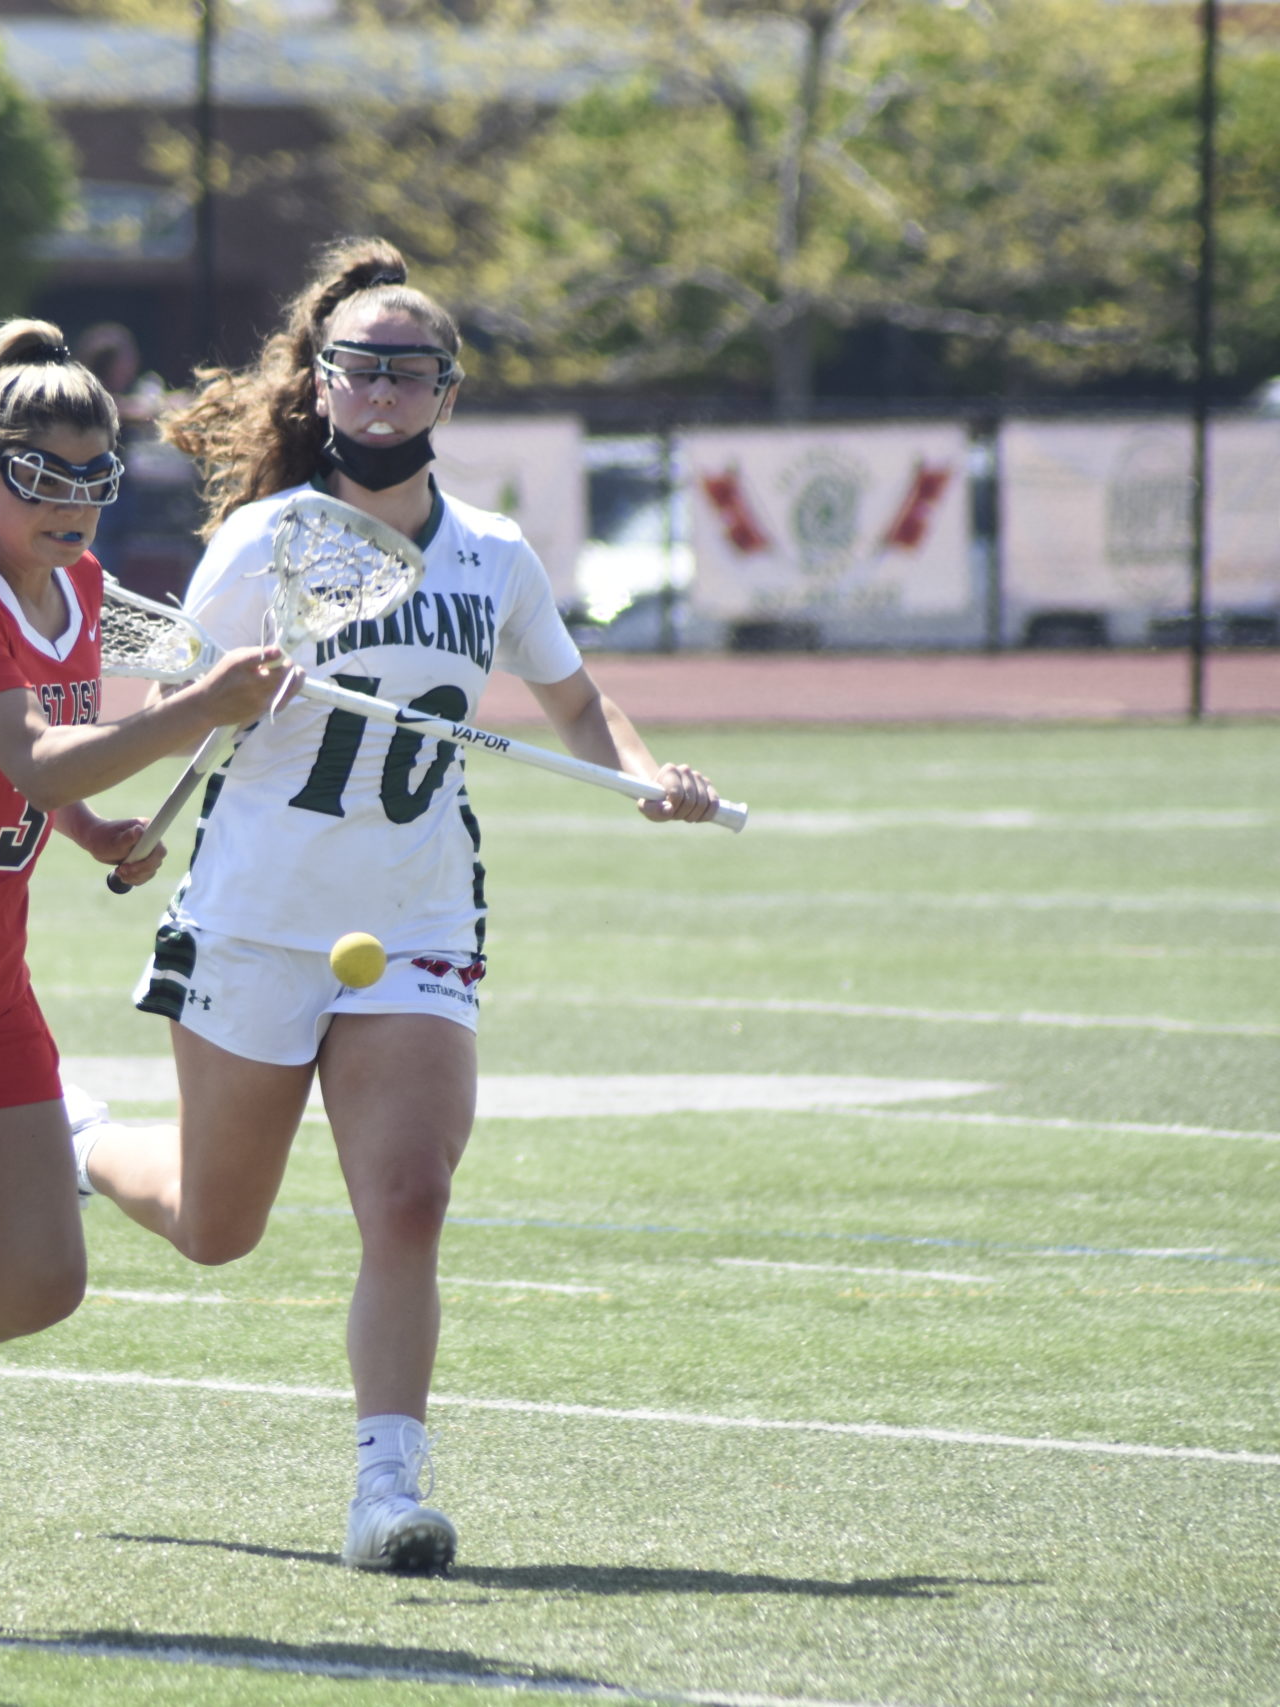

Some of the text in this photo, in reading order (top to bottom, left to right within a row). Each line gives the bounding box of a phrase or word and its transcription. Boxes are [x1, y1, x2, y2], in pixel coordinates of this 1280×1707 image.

[31, 679, 102, 727] ST ISL
[287, 673, 468, 824] 10
[451, 723, 510, 752] VAPOR
